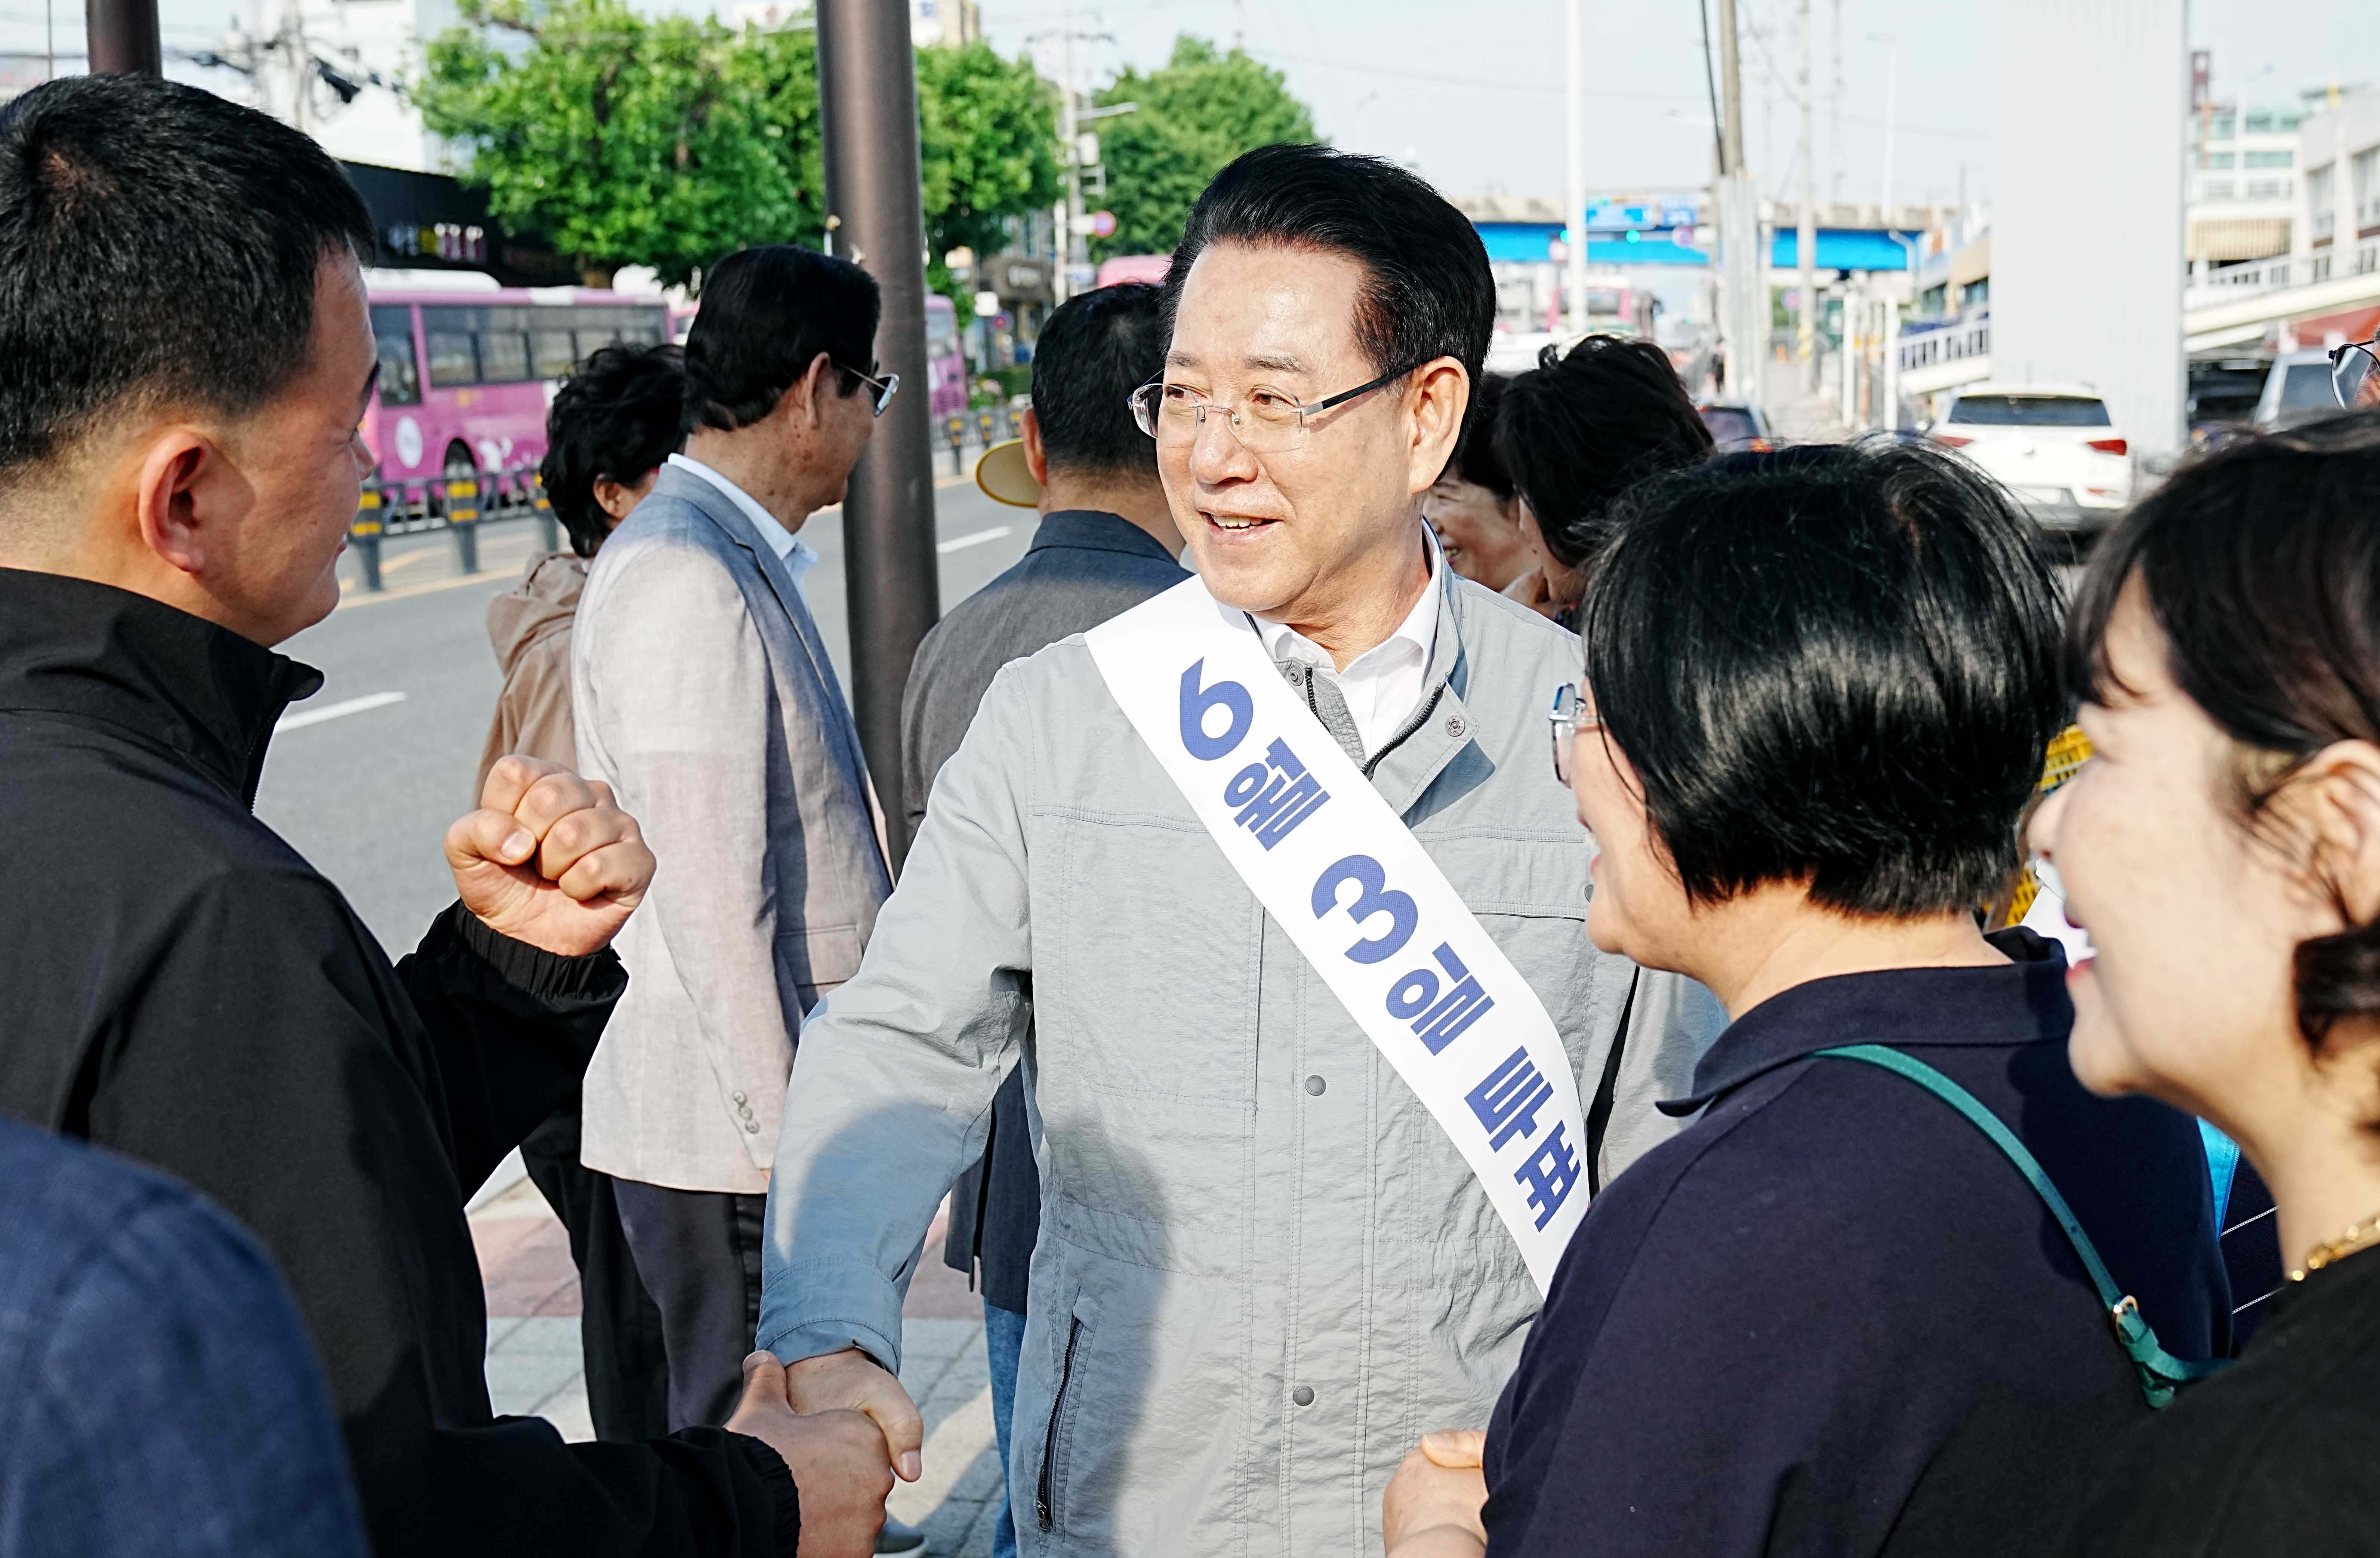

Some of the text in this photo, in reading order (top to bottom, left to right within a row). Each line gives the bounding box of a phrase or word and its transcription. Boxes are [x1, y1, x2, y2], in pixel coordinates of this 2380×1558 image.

[1180, 657, 1581, 1232] 6월 3일 투표
